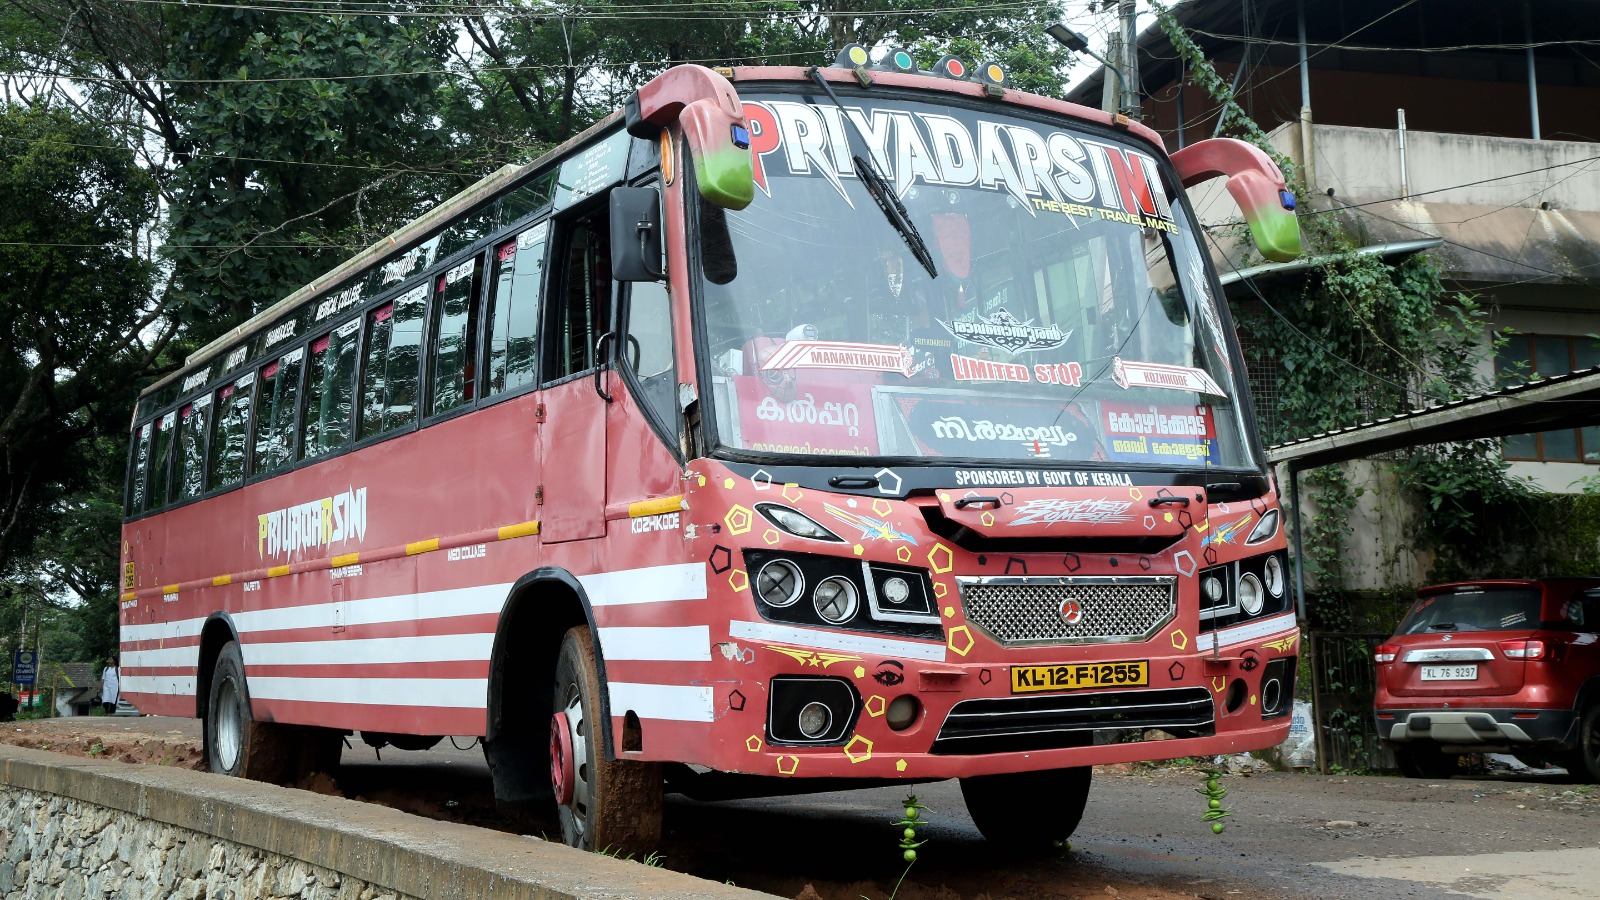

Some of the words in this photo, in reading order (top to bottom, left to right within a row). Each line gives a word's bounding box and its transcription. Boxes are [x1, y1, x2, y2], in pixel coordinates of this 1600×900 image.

[739, 99, 1175, 232] PRIYADARSINI
[1032, 198, 1060, 212] THE
[1061, 202, 1094, 218] BEST
[1097, 208, 1146, 227] TRAVEL
[1147, 217, 1179, 235] MATE
[811, 351, 900, 368] MANANTHAVADY
[951, 354, 1030, 382] LIMITED
[1034, 362, 1082, 388] STOP
[1143, 371, 1189, 387] KOZHIKODE
[955, 470, 1025, 486] SPONSORED
[1026, 472, 1040, 485] BY
[1043, 472, 1073, 487] GOVT
[1075, 473, 1089, 486] OF
[1090, 473, 1133, 487] KERALA
[631, 513, 680, 534] KOZHIKODE
[1427, 668, 1437, 678] KL
[1440, 668, 1451, 678] 76
[1455, 667, 1476, 677] 9297
